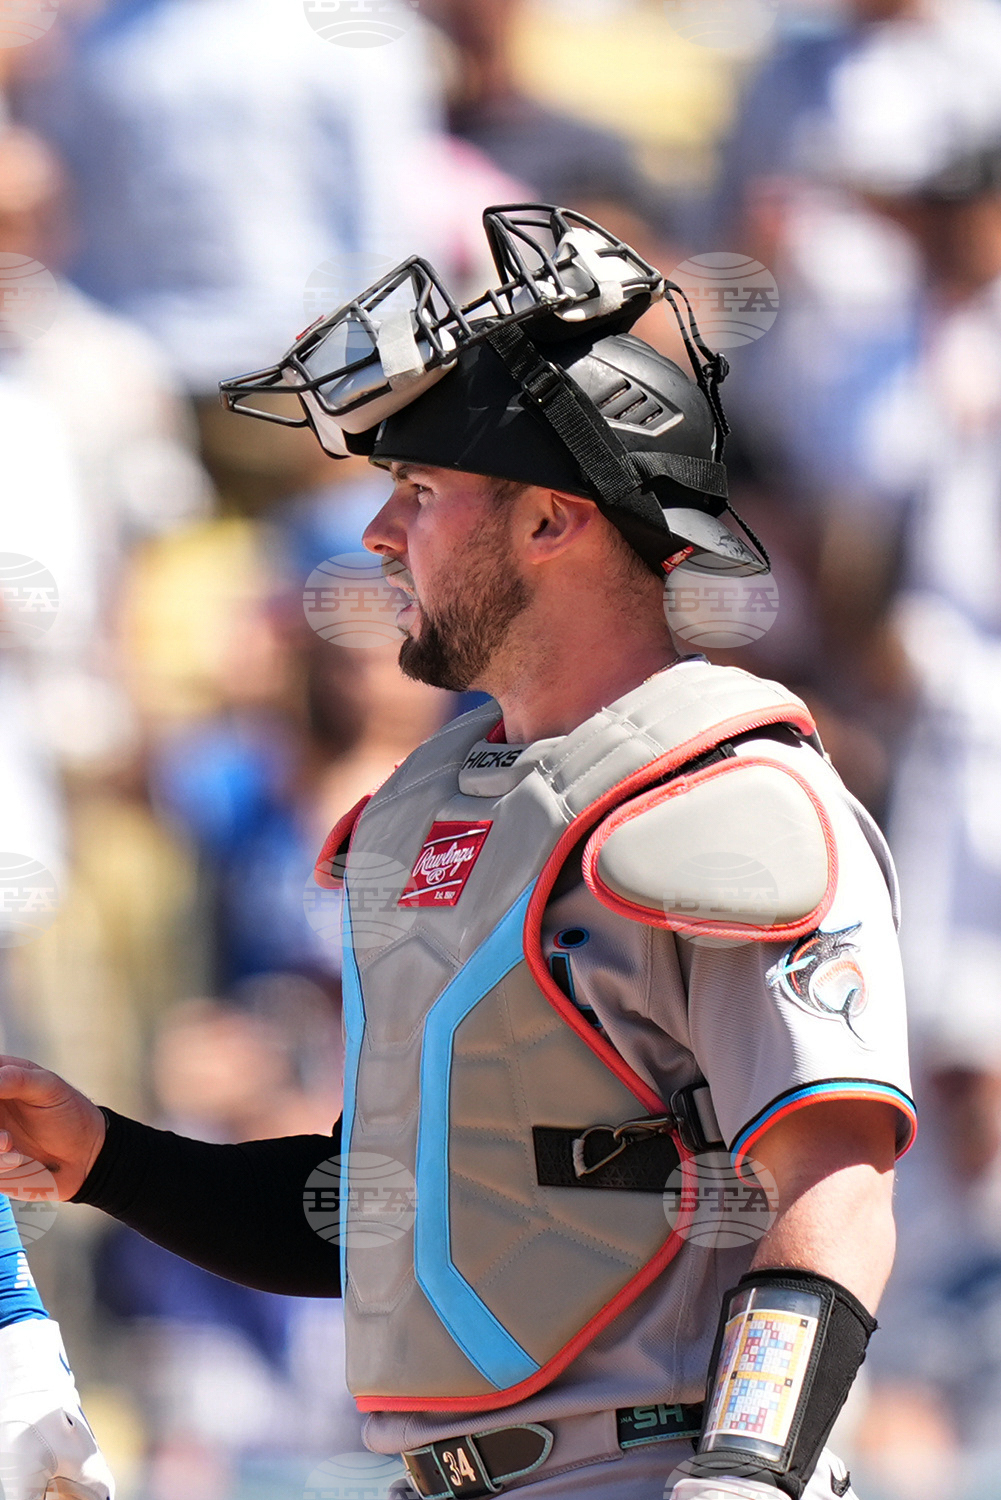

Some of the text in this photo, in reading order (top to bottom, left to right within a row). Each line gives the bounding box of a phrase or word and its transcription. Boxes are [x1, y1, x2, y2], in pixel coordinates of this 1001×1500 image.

[461, 749, 524, 771] HICKS
[412, 842, 475, 877] Rawlings
[443, 1448, 476, 1486] 34
